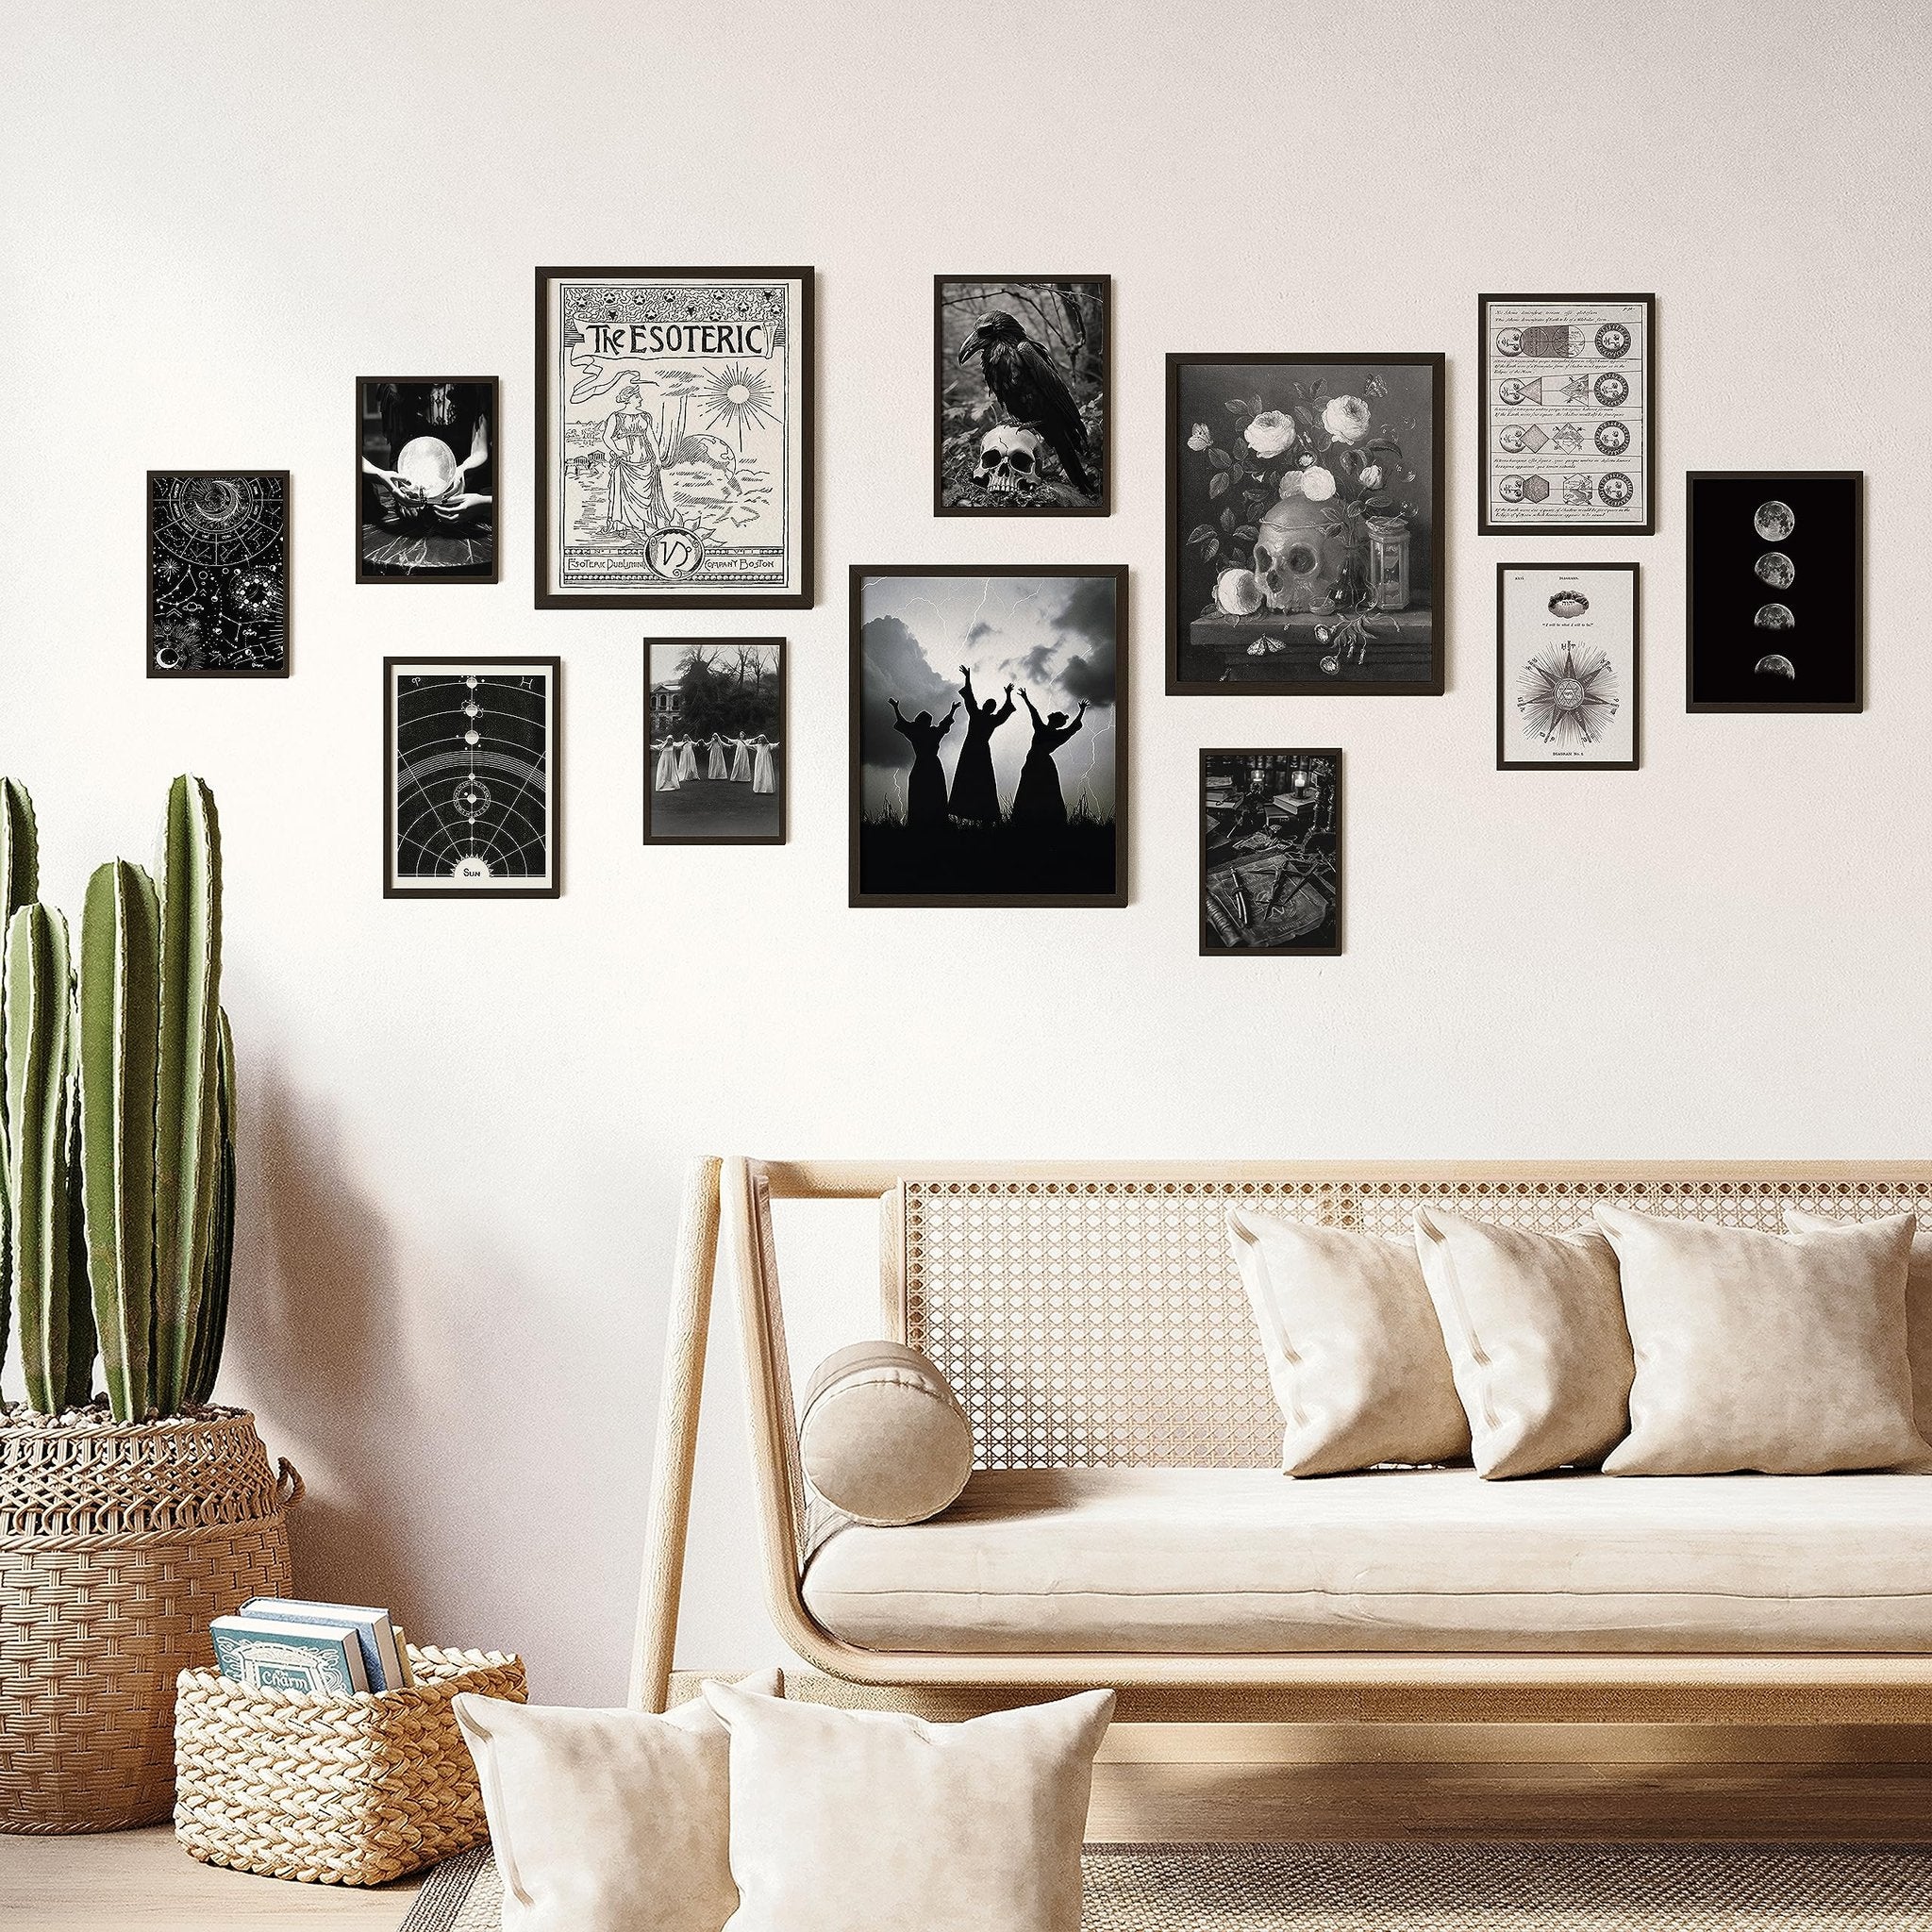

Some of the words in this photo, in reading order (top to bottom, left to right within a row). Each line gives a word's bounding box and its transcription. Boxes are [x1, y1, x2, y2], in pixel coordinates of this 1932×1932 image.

[586, 325, 625, 356] The
[629, 325, 763, 354] ESOTERIC
[705, 558, 738, 572] COMPANY
[739, 558, 774, 571] BOSTON
[261, 1670, 309, 1691] Charm
